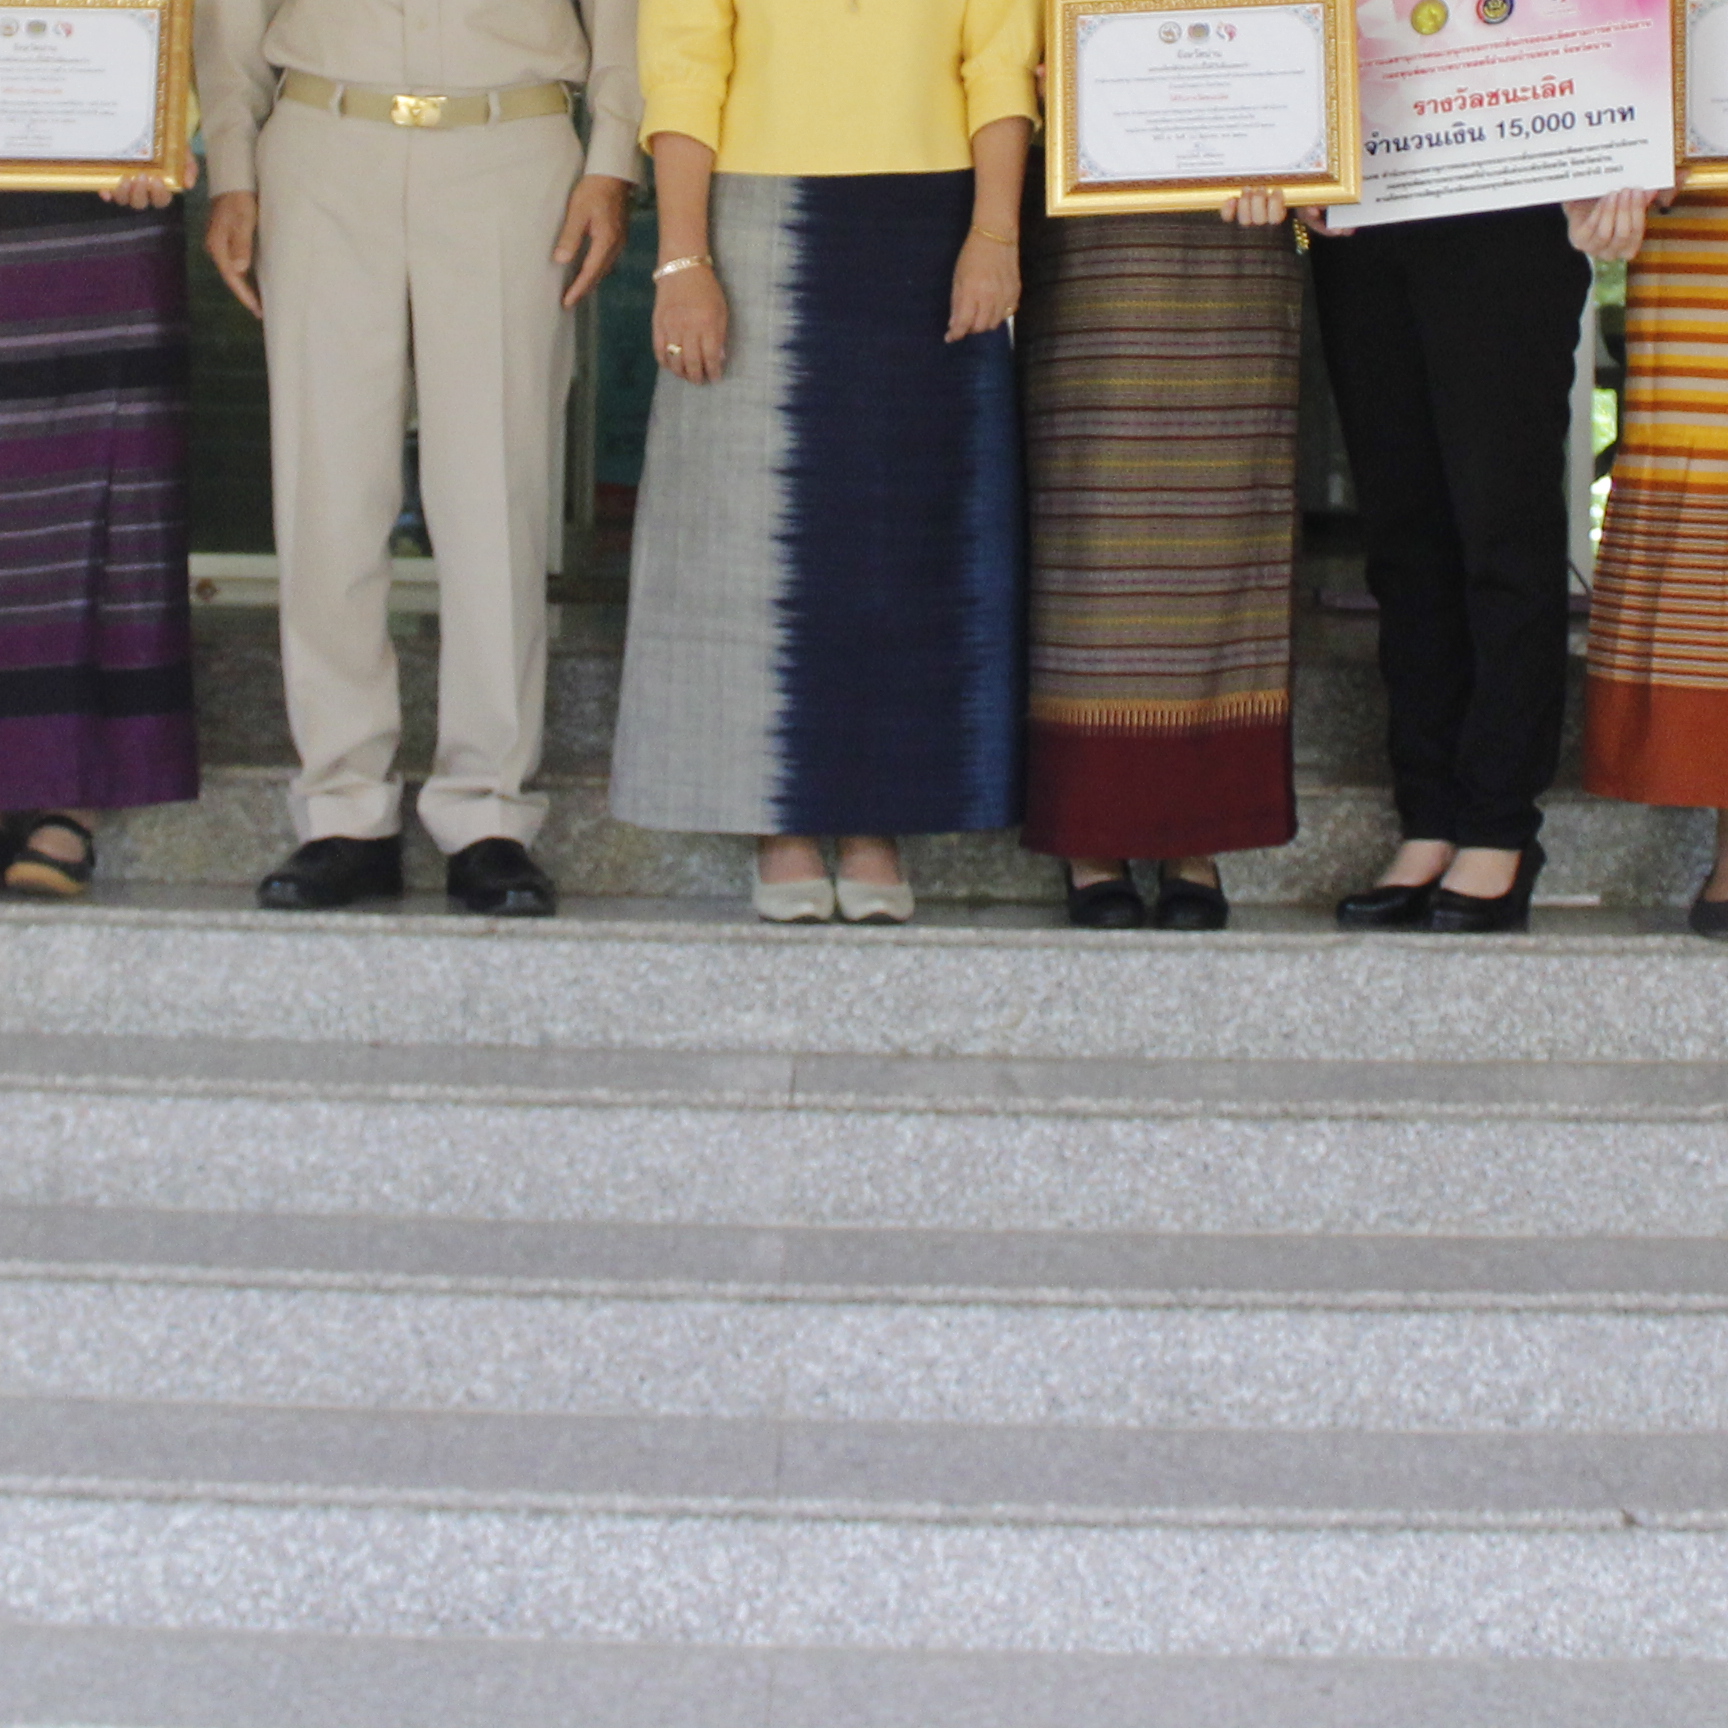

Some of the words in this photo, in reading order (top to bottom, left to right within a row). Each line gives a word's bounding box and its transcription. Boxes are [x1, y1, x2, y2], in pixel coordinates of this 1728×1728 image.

[1413, 75, 1575, 116] รางวัลชนะเลิศ
[1364, 121, 1486, 156] จำนวนเงิน
[1495, 111, 1576, 140] 15,000
[1584, 105, 1635, 127] บาท
